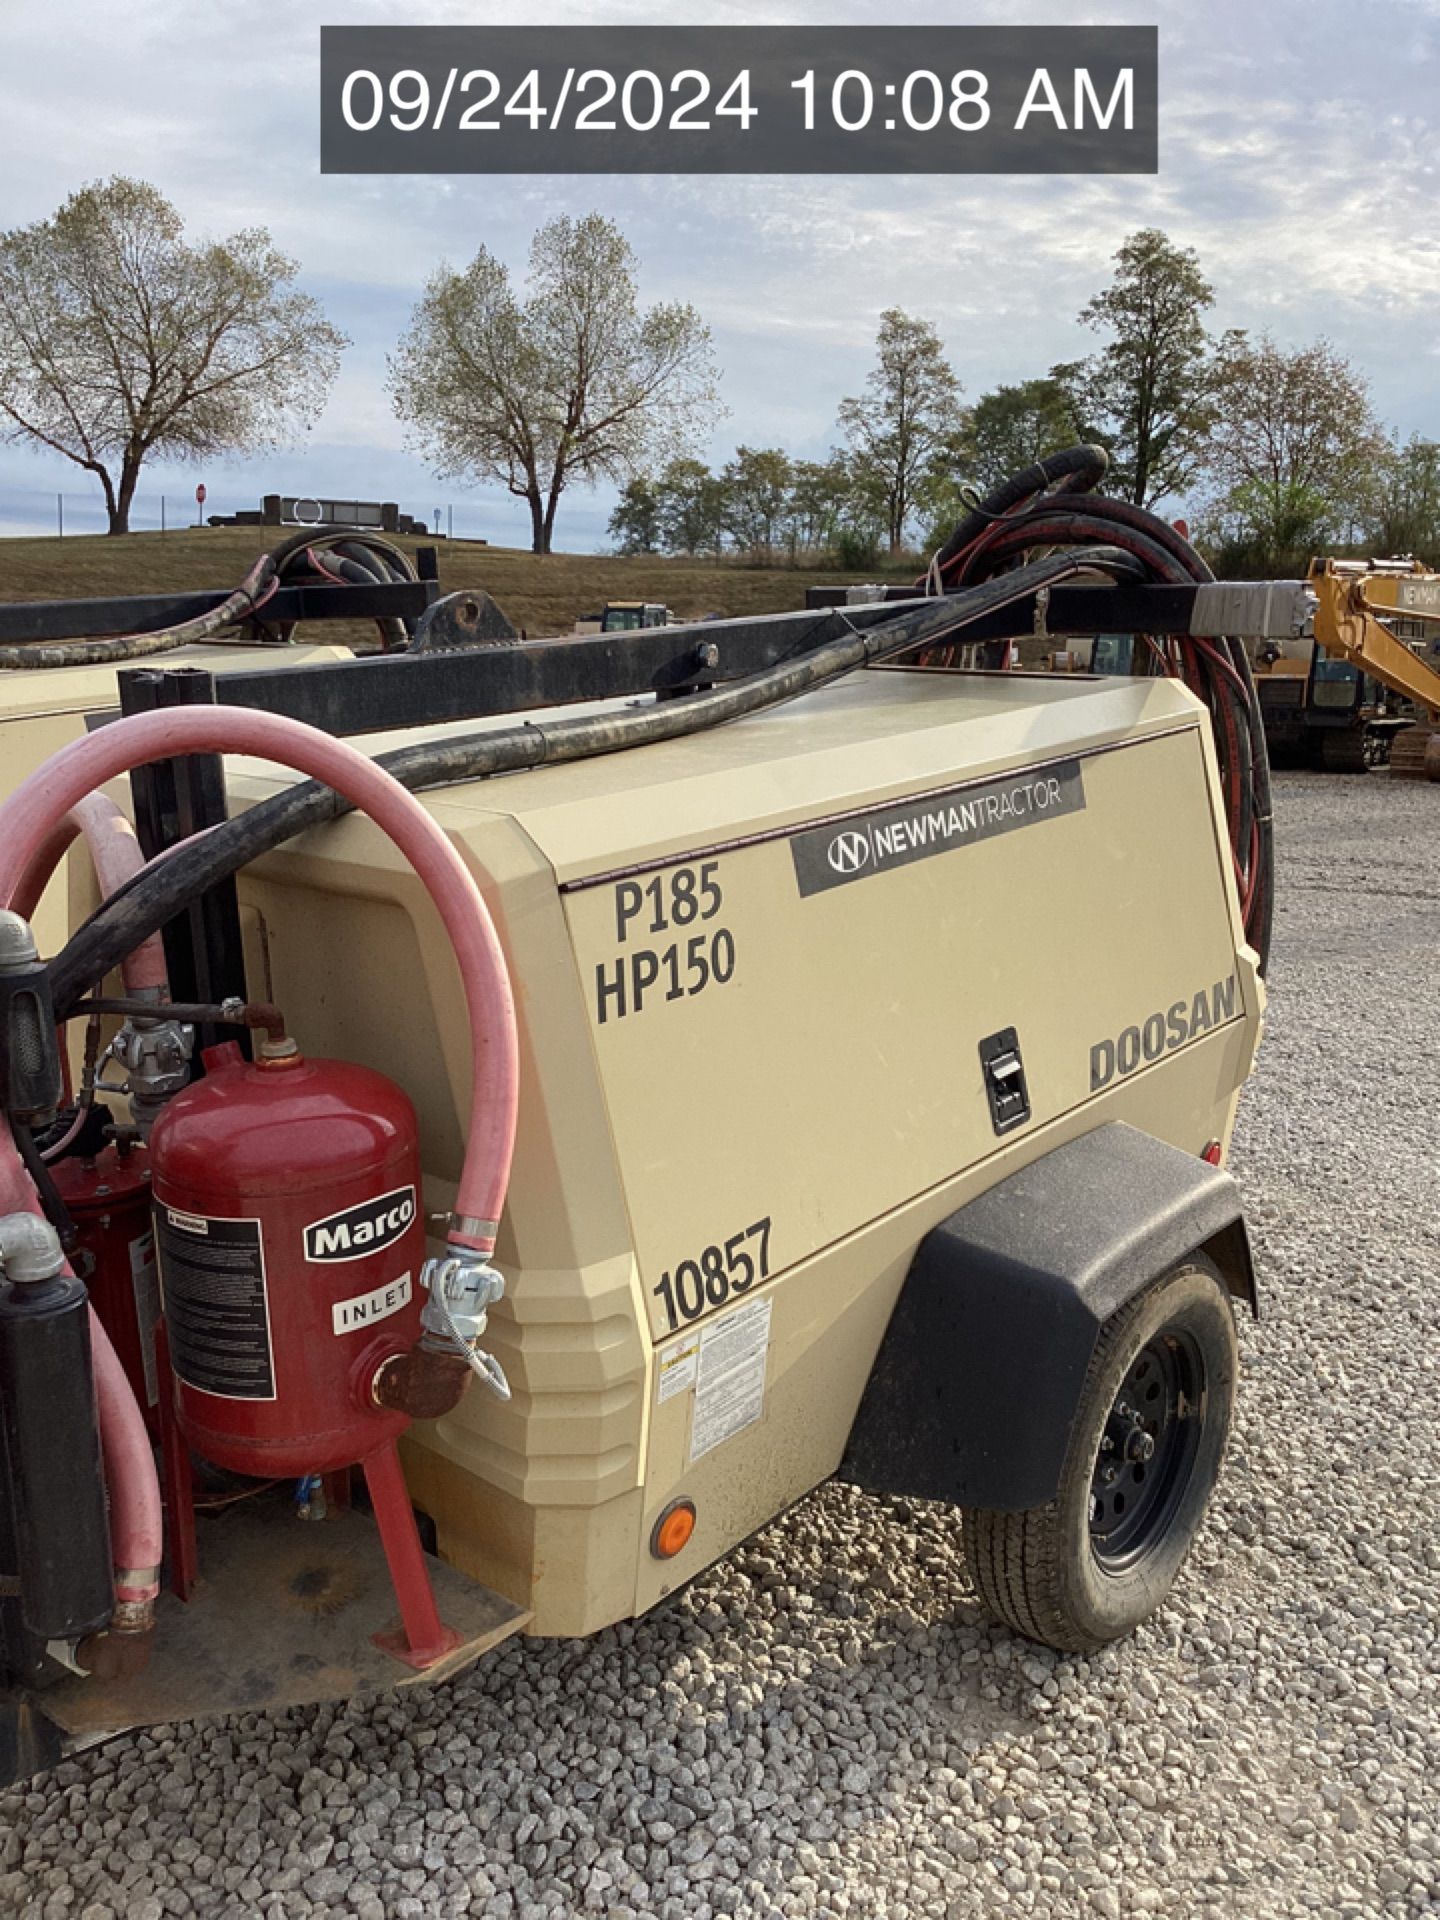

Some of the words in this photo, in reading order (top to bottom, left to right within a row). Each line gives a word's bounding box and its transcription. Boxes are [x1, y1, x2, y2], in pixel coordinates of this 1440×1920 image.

[615, 861, 722, 943] P185
[596, 928, 735, 1025] HP150
[1090, 975, 1235, 1092] DOOSAN
[315, 1199, 413, 1256] Marco
[342, 1281, 408, 1325] INLET
[654, 1216, 771, 1330] 10857
